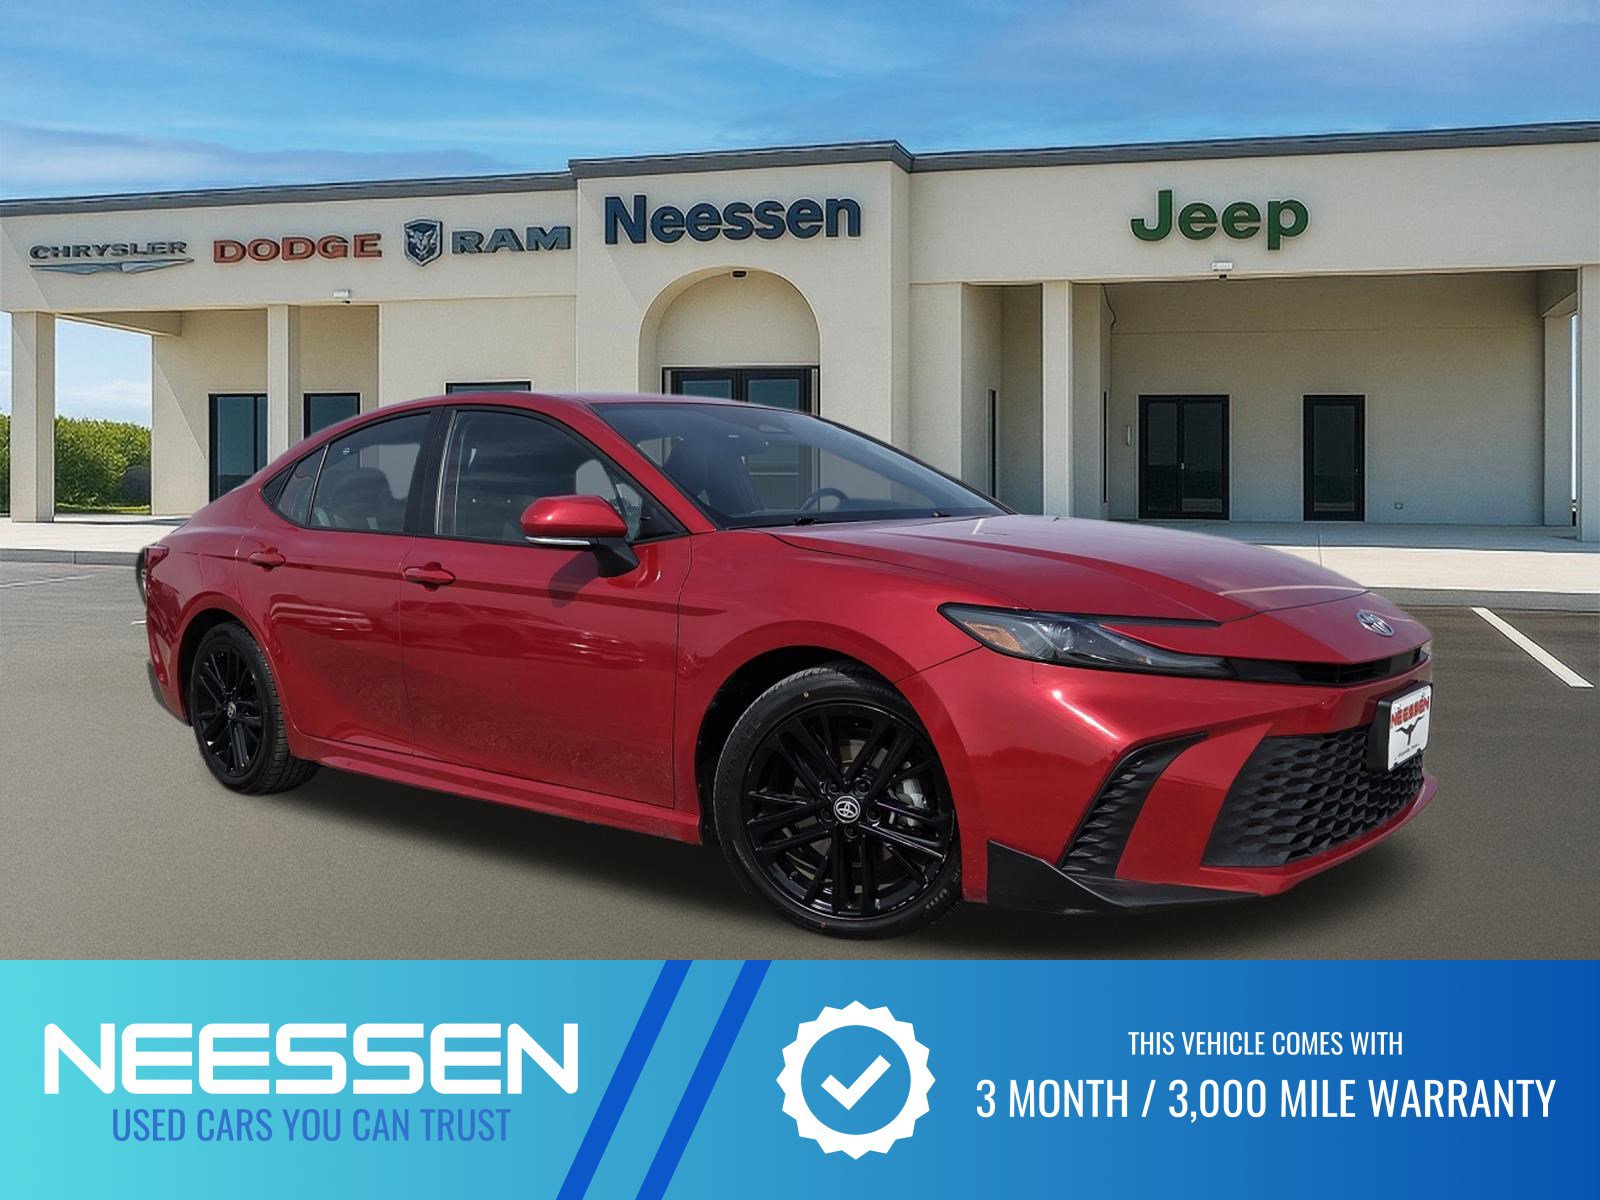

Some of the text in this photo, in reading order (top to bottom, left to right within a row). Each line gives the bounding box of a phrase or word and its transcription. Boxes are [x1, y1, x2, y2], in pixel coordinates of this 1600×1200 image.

[604, 194, 862, 245] Neessen
[1130, 189, 1309, 250] Jeep
[29, 241, 188, 259] CHRYSLER
[213, 233, 382, 264] DODGE
[451, 226, 572, 254] RAM
